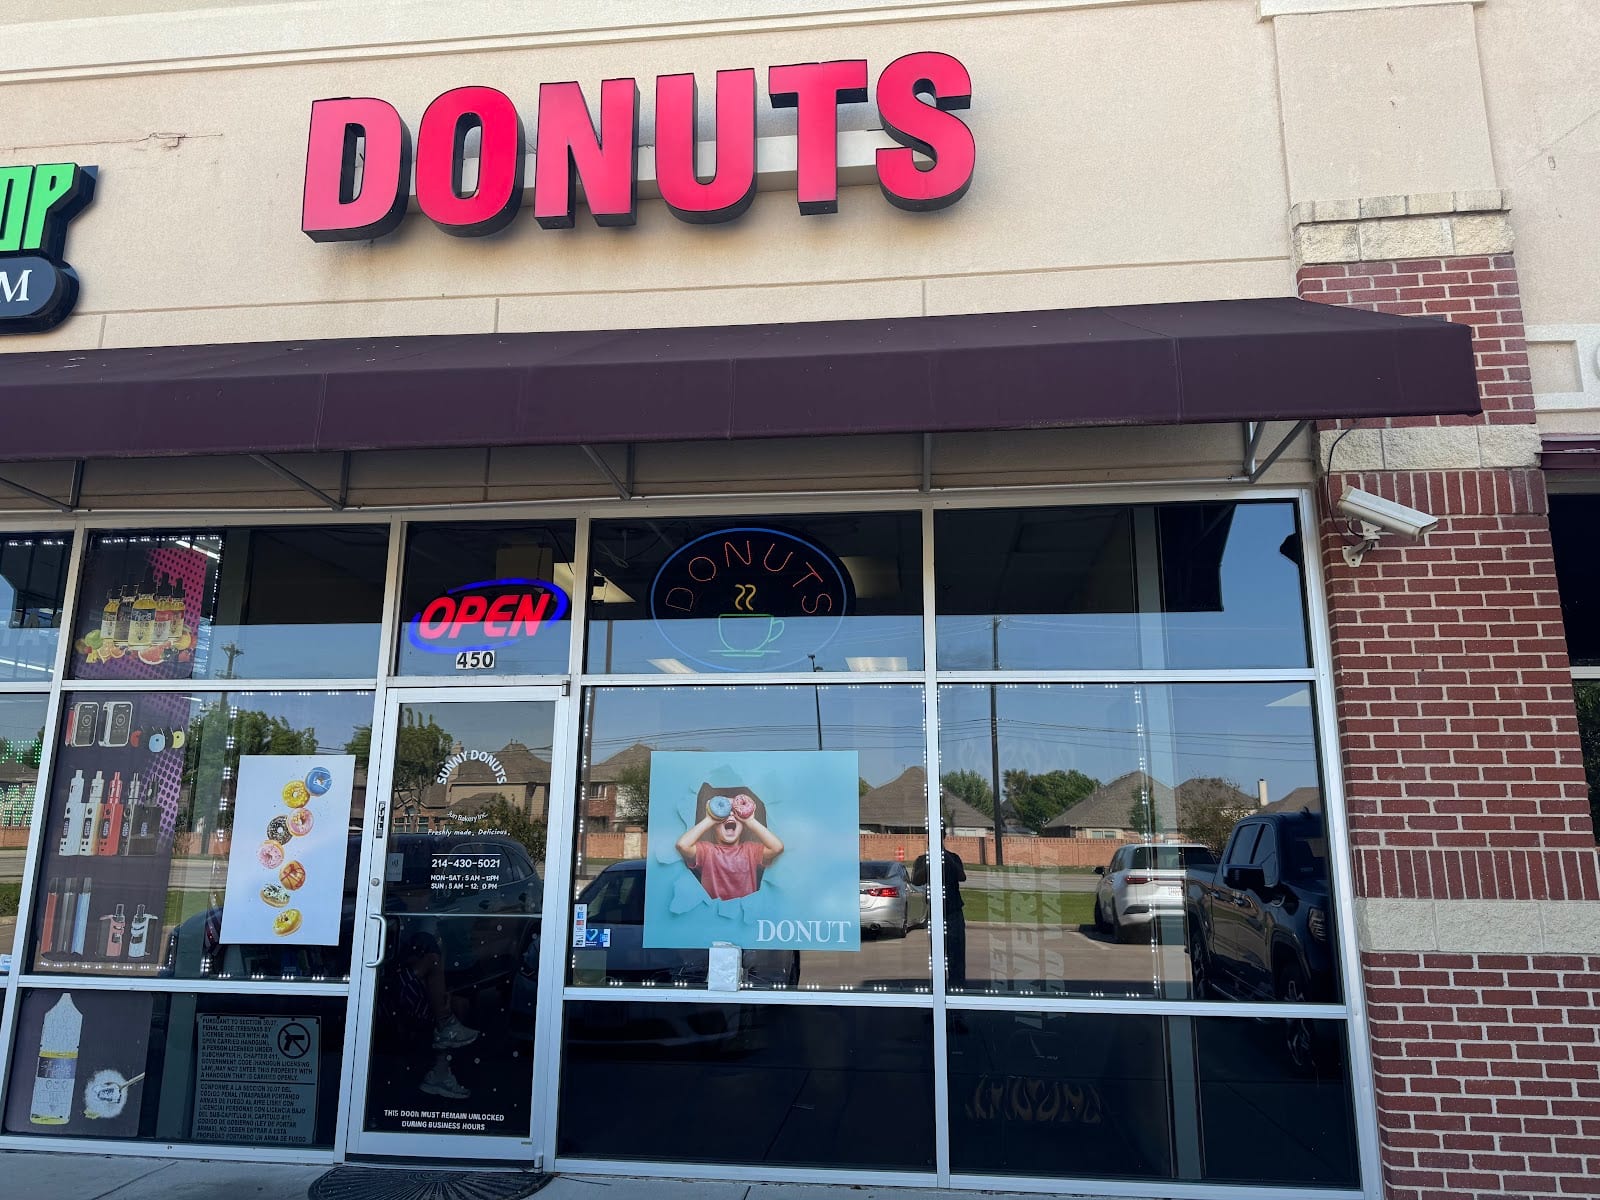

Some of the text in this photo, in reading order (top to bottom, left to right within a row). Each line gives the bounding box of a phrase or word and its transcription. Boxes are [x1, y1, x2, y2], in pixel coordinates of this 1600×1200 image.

[302, 51, 976, 238] DONUTS
[665, 540, 832, 614] DONUTS
[419, 593, 550, 639] OPEN
[456, 652, 494, 668] 450
[437, 749, 507, 785] SUNNY DONUTS
[457, 814, 477, 823] Bakery
[428, 828, 452, 837] Freshly
[431, 858, 500, 868] 214-430-5021
[756, 919, 852, 943] DONUT
[384, 1109, 505, 1122] THIS DOOR MUST REMAIN UNLOCKED
[401, 1120, 486, 1131] DURING BUSINESS HOURS
